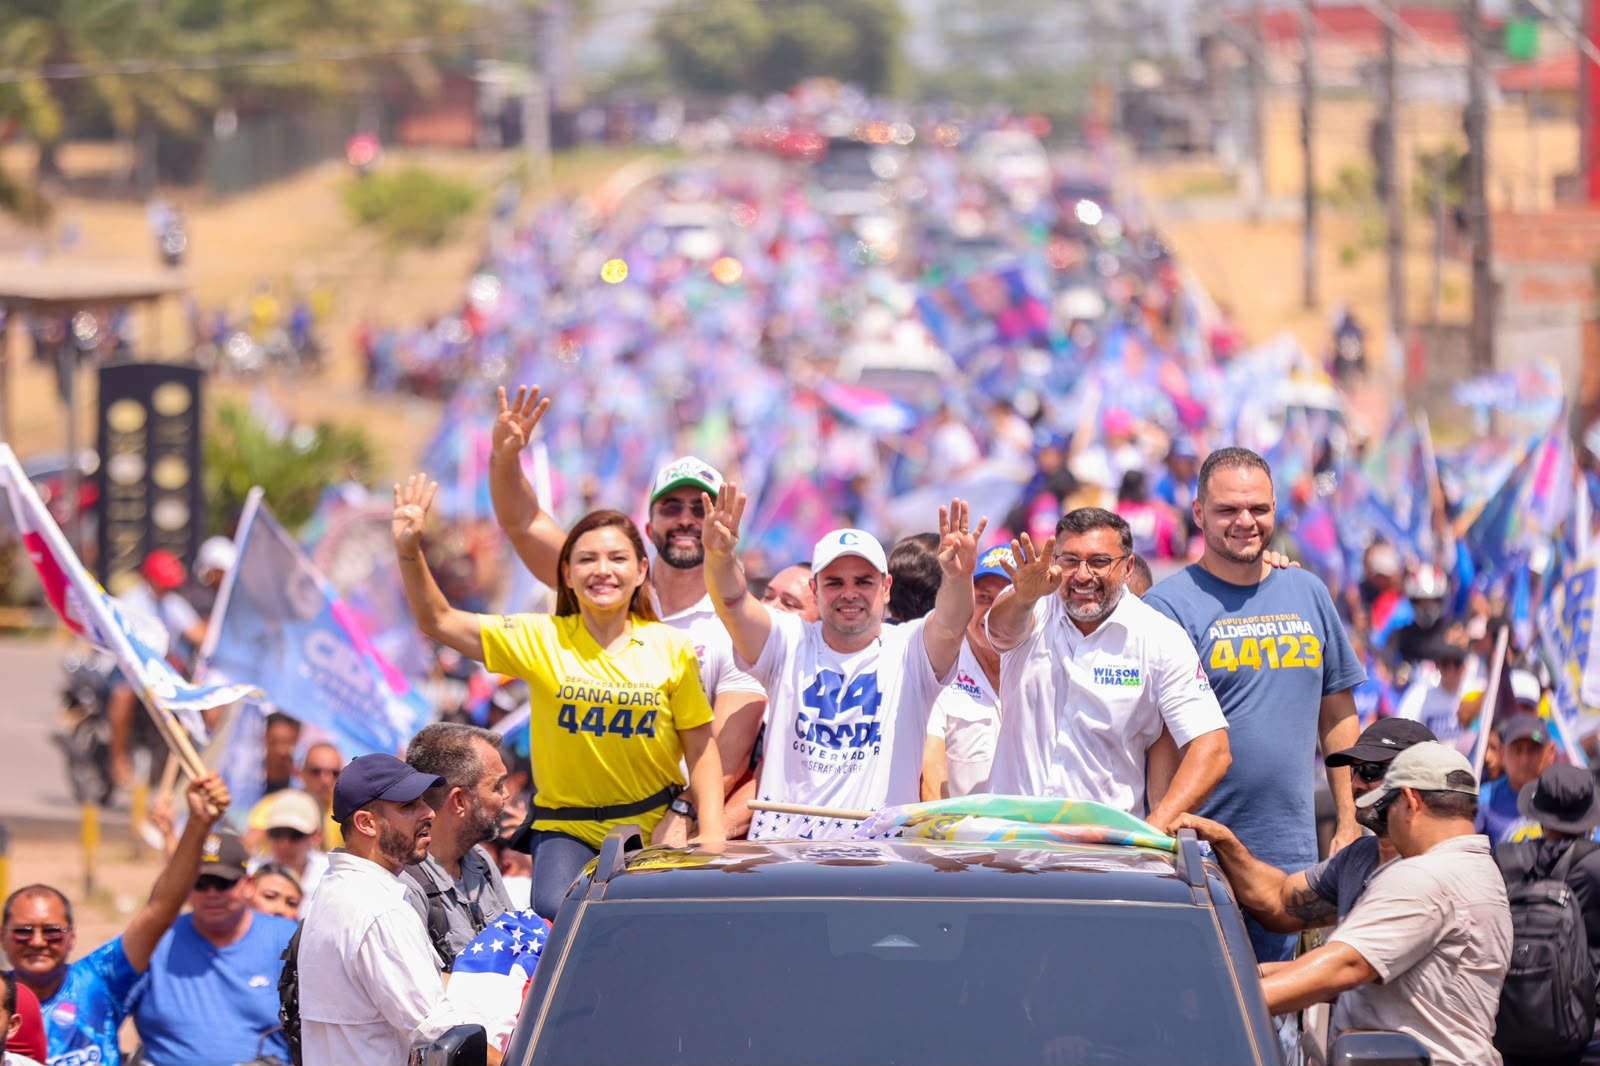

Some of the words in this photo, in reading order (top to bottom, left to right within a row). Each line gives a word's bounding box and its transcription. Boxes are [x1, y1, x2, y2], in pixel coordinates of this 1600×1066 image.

[1209, 623, 1279, 640] ALDENOR
[1278, 620, 1314, 635] LIMA
[1215, 616, 1260, 627] DEPUTADO
[1260, 613, 1301, 623] ESTADUAL
[1210, 634, 1323, 672] 44123
[1093, 667, 1140, 678] WILSON
[1094, 676, 1122, 686] LIMA
[565, 676, 614, 689] DEPUTADA
[616, 681, 656, 690] FEDERAL
[556, 685, 613, 704] JOANA
[618, 691, 661, 707] DARC
[802, 668, 882, 721] 44
[557, 703, 658, 739] 4444
[793, 740, 880, 761] GOVERNADR
